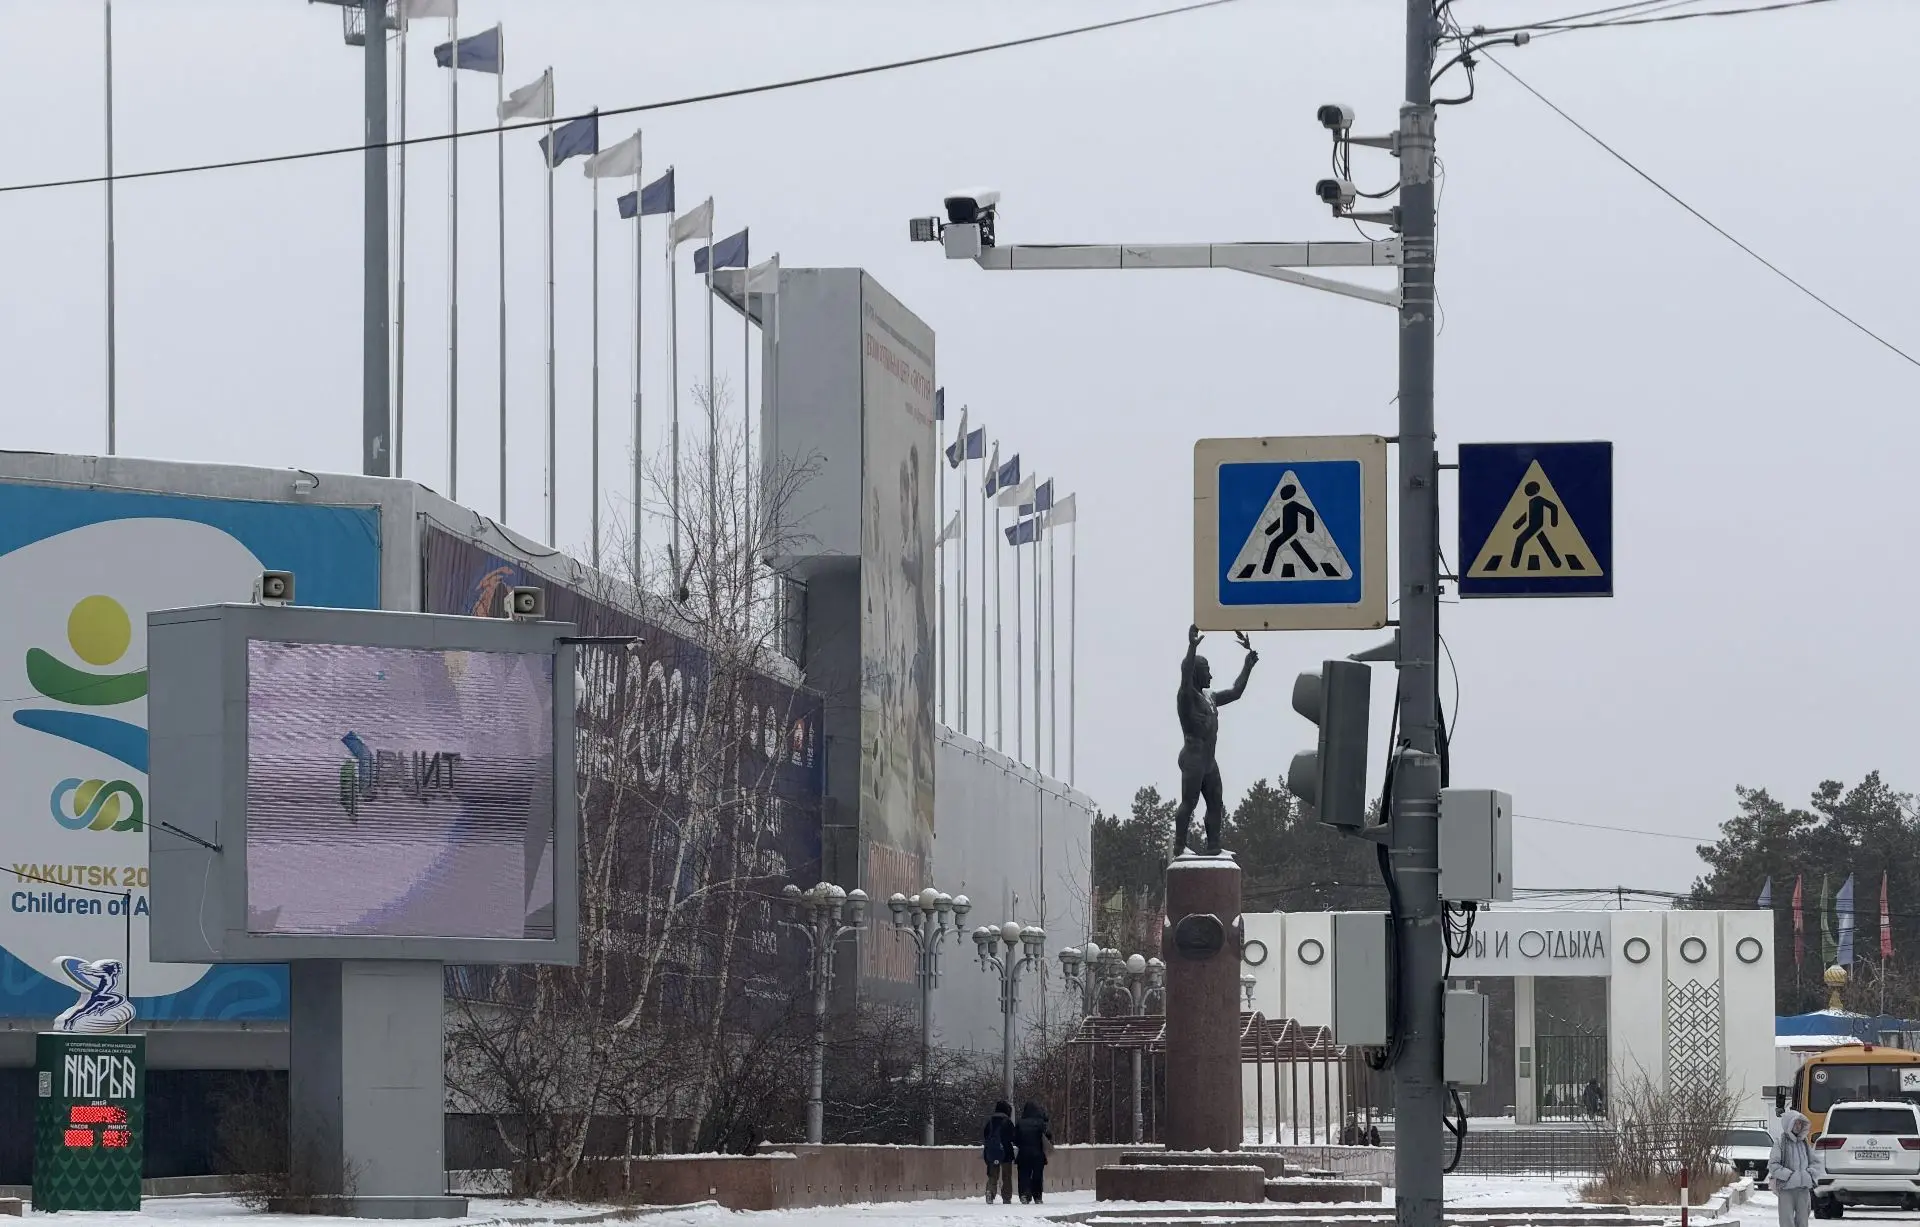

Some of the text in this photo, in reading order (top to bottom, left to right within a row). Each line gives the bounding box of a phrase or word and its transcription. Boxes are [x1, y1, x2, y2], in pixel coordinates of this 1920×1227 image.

[12, 863, 149, 888] YAKUTSK 20
[11, 891, 102, 915] Children
[107, 895, 131, 916] of
[1495, 930, 1509, 959] И
[1518, 930, 1605, 959] ОТДЫХА
[63, 1054, 137, 1099] НЮРБА
